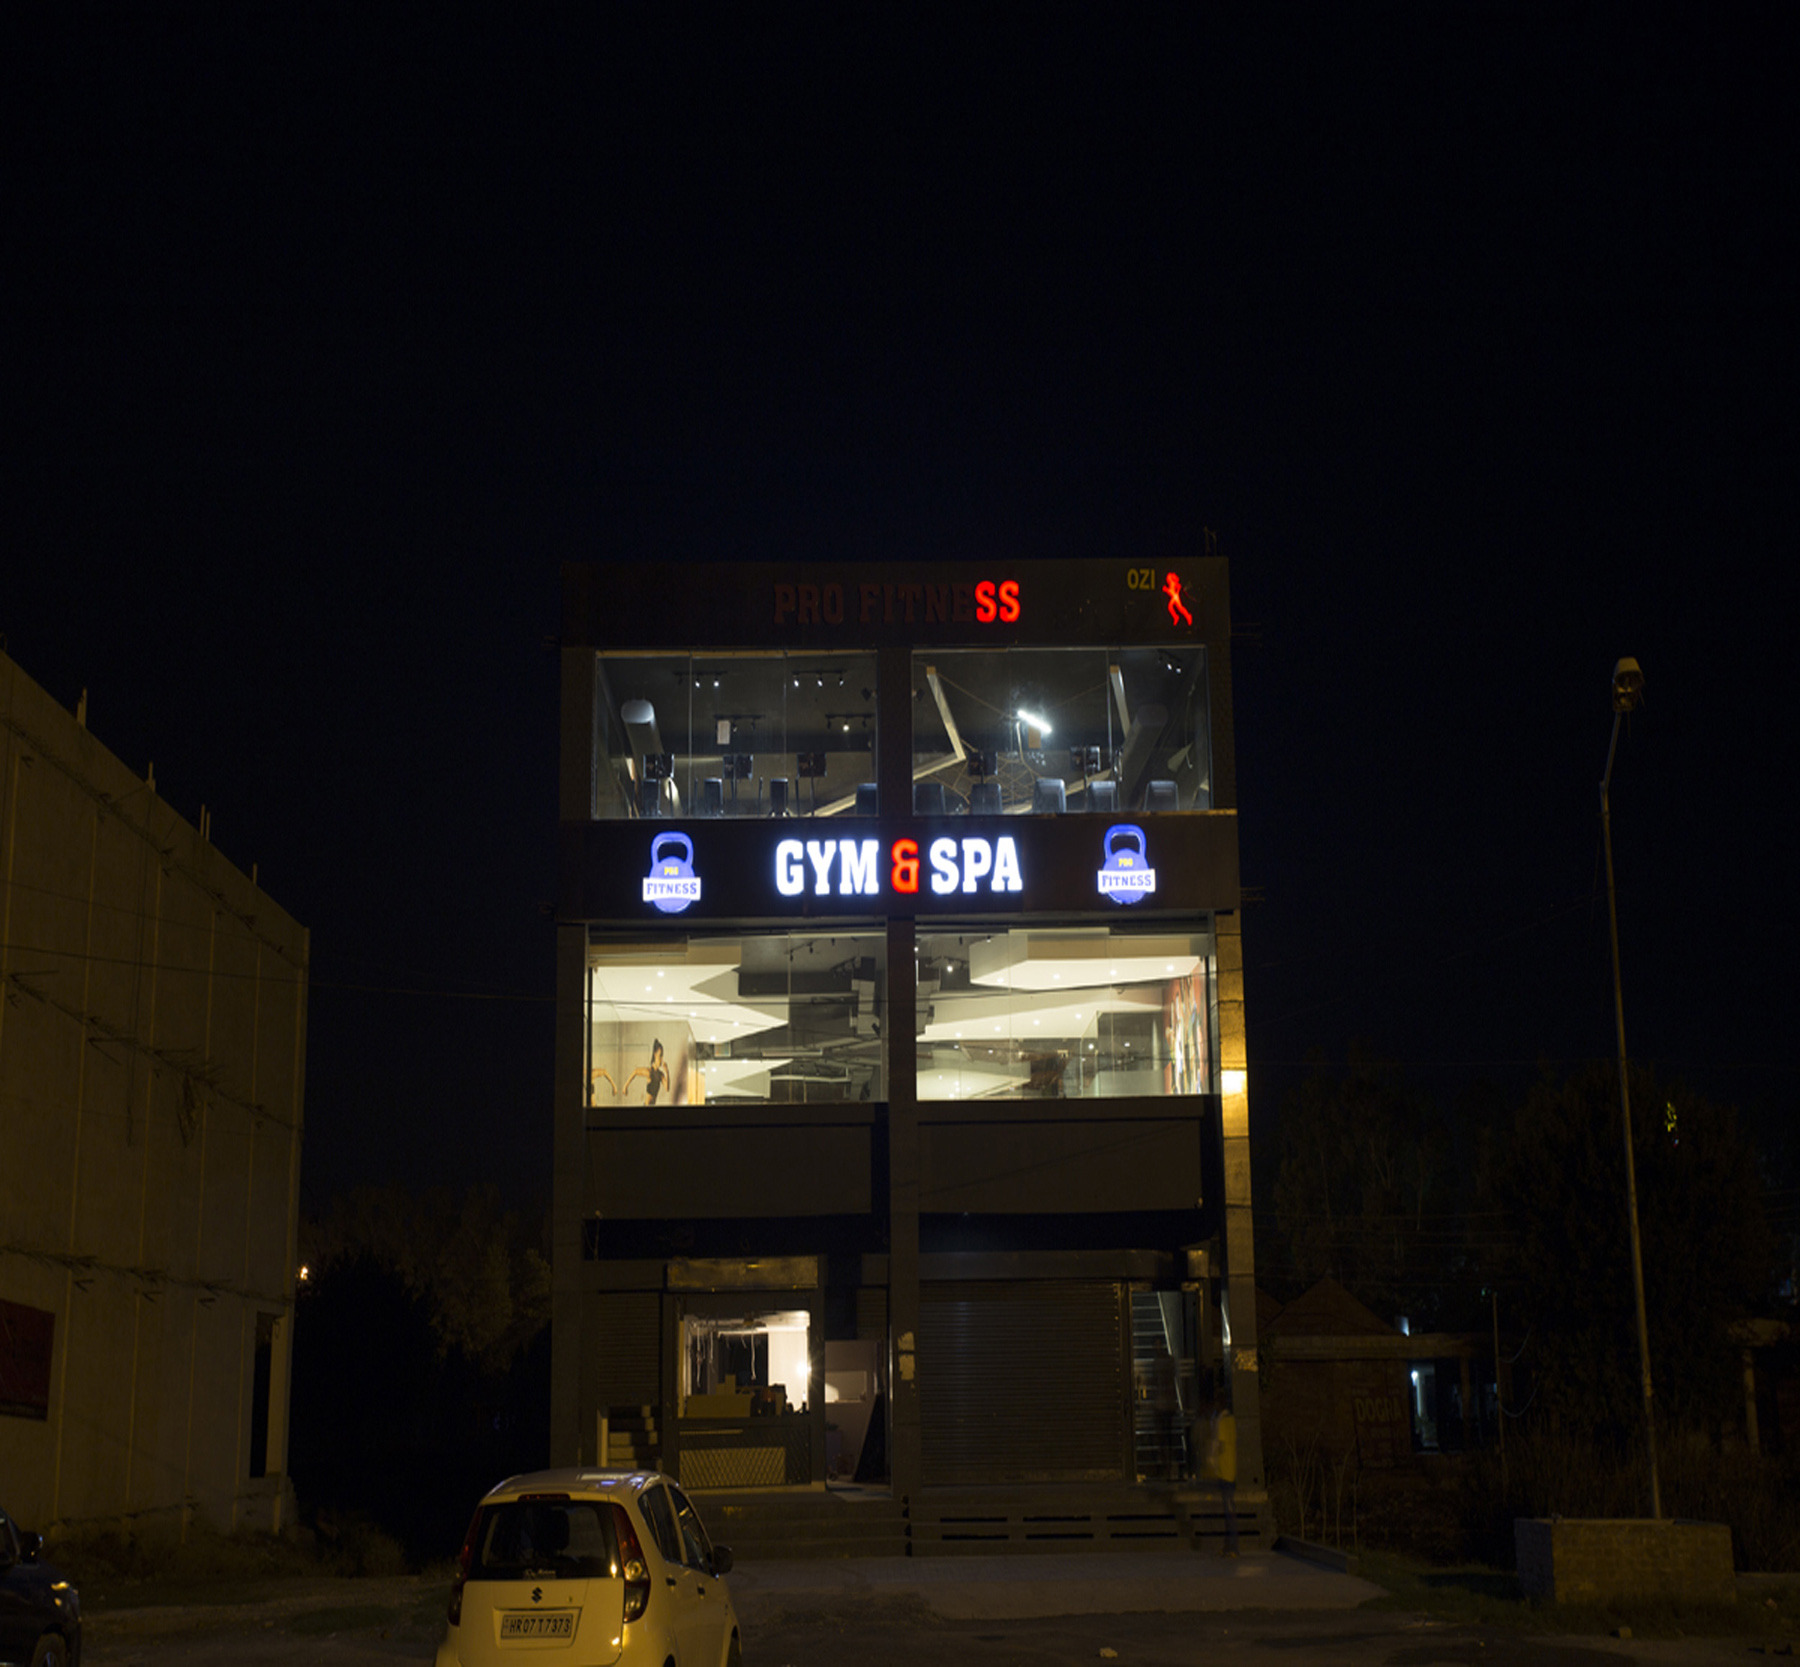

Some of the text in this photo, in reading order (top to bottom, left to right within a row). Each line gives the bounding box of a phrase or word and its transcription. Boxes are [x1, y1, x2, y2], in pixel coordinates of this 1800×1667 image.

[1126, 567, 1156, 590] OZI
[773, 579, 1021, 625] PRO FITNESS
[775, 836, 1023, 896] GYM & SPA
[646, 882, 697, 895] FITNESS
[1101, 874, 1152, 887] FITNESS
